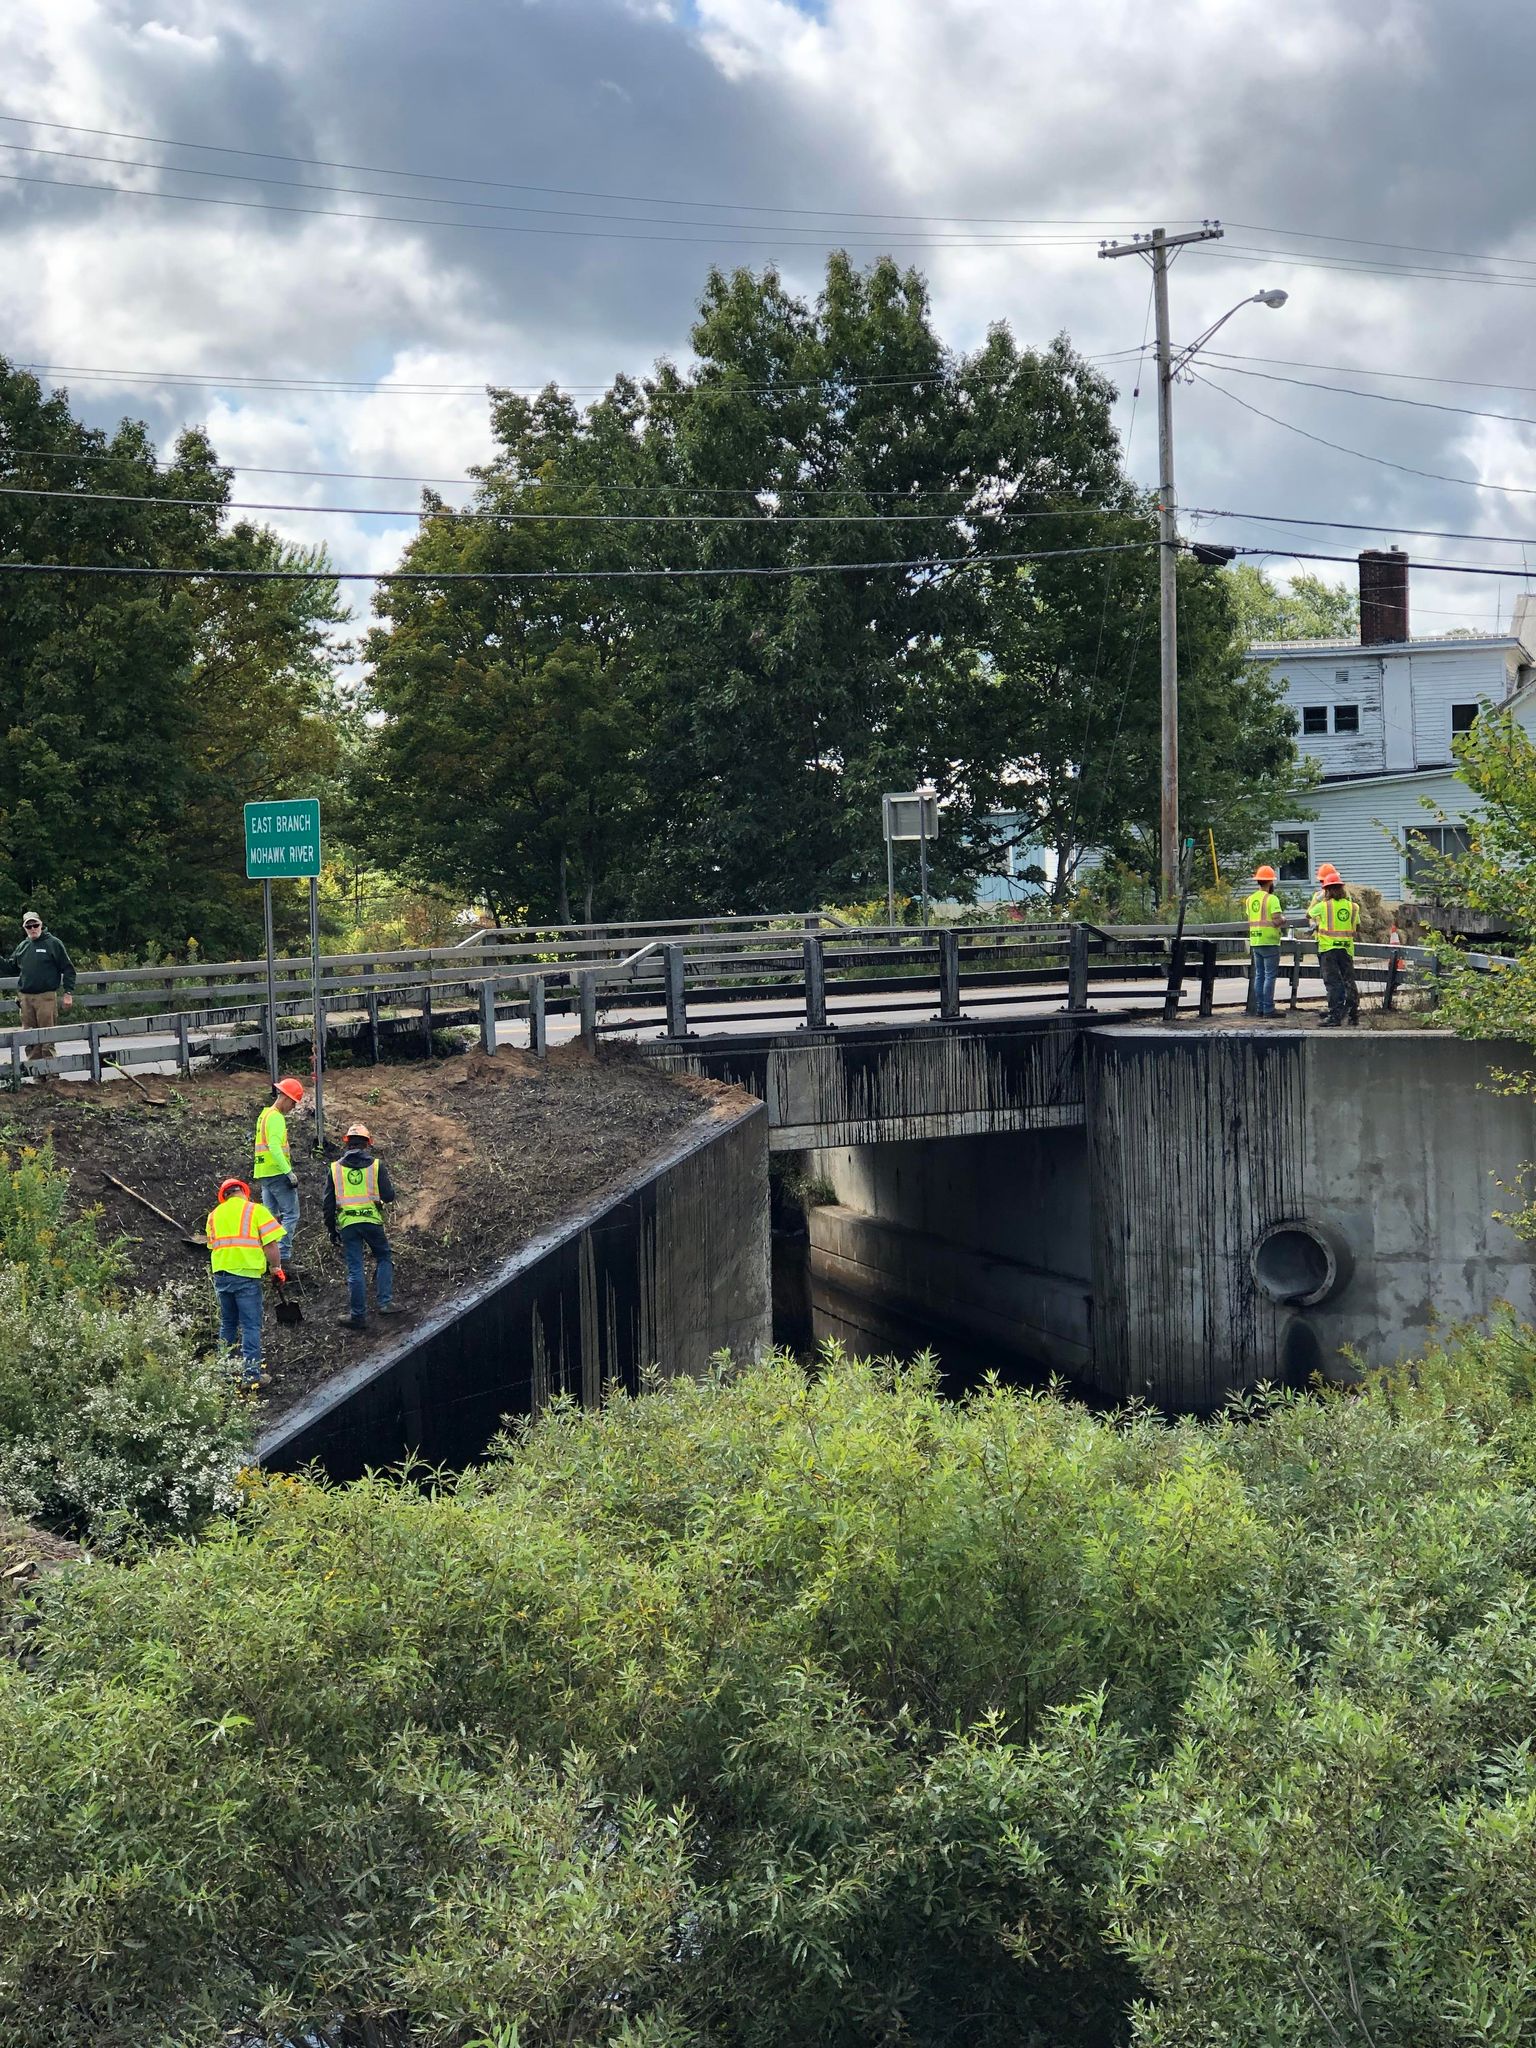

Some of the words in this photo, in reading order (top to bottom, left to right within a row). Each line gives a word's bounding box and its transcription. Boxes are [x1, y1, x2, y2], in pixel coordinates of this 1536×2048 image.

[251, 816, 272, 834] EAST
[276, 814, 311, 832] BRANCH
[250, 846, 286, 864] MOHAWK
[289, 845, 314, 863] RIVER
